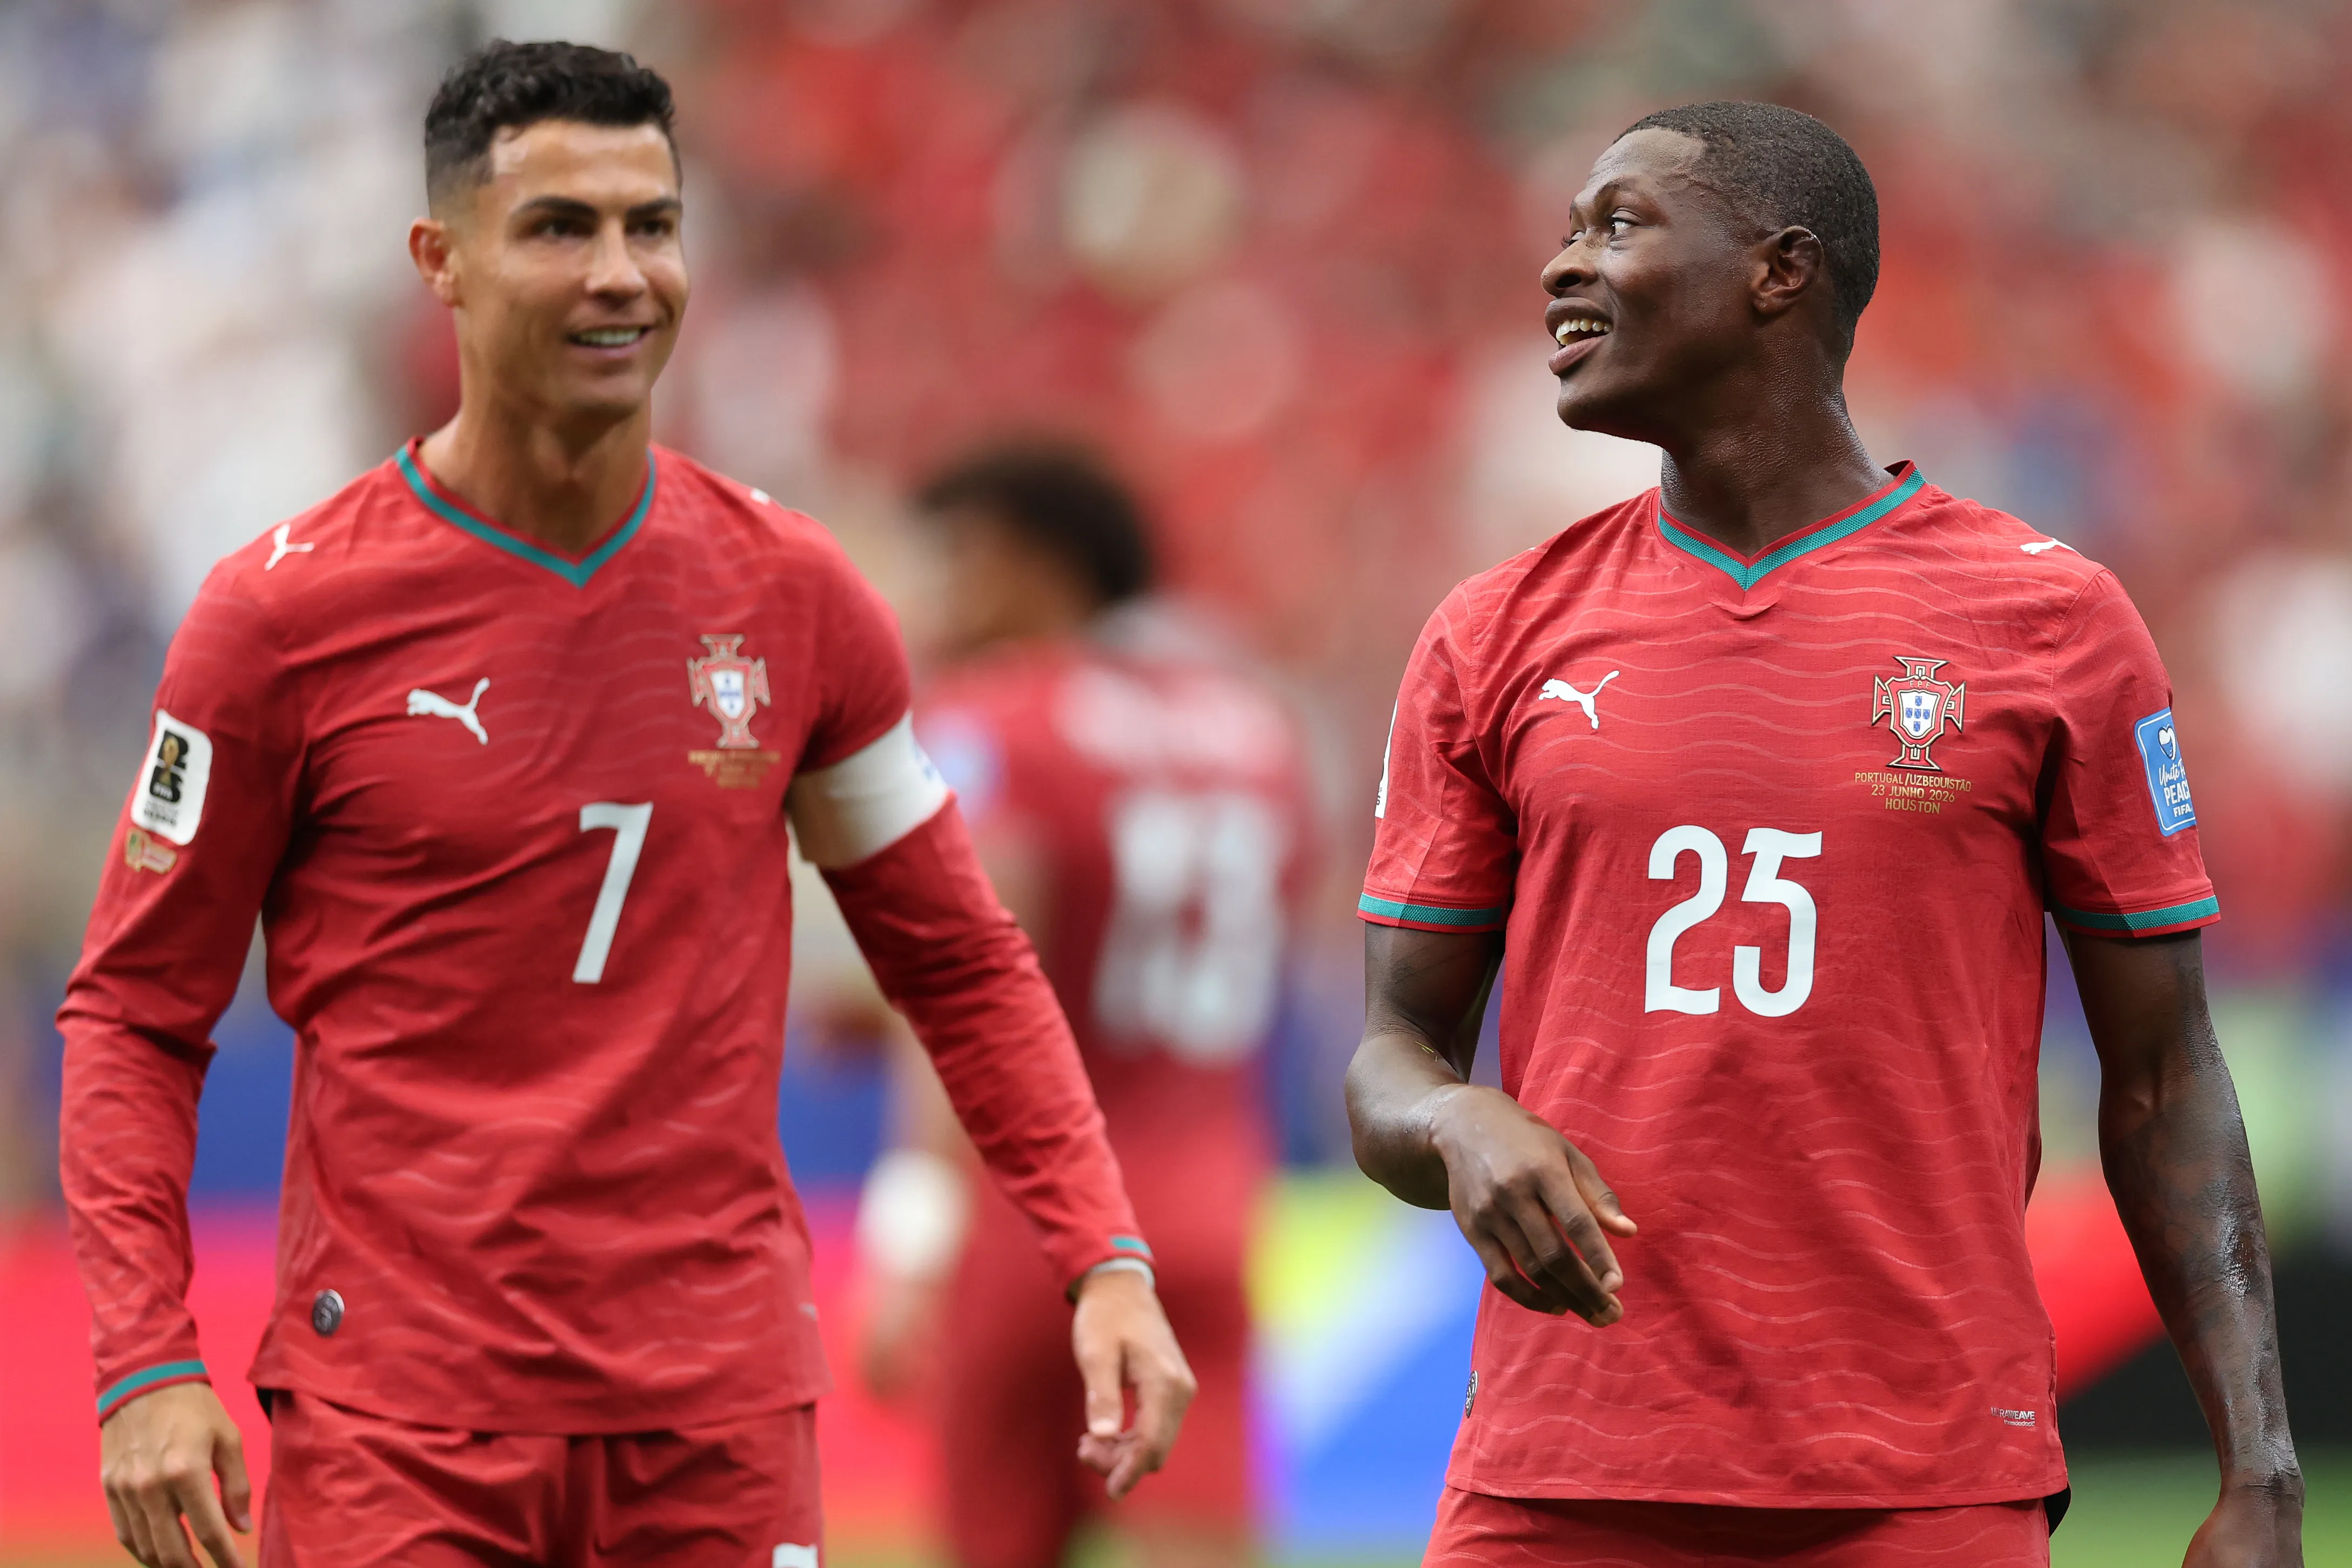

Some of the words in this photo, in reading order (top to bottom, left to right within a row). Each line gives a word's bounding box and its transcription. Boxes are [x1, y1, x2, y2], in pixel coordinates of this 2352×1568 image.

[2159, 763, 2180, 787] Unite
[1871, 784, 1885, 796] 23
[1888, 786, 1925, 799] JUNHO
[1928, 789, 1955, 802] 2026
[2164, 780, 2191, 807] PEAC
[1885, 798, 1940, 814] HOUSTON
[2173, 803, 2192, 817] FIFA
[572, 801, 654, 983] 7
[1645, 825, 1822, 1017] 25
